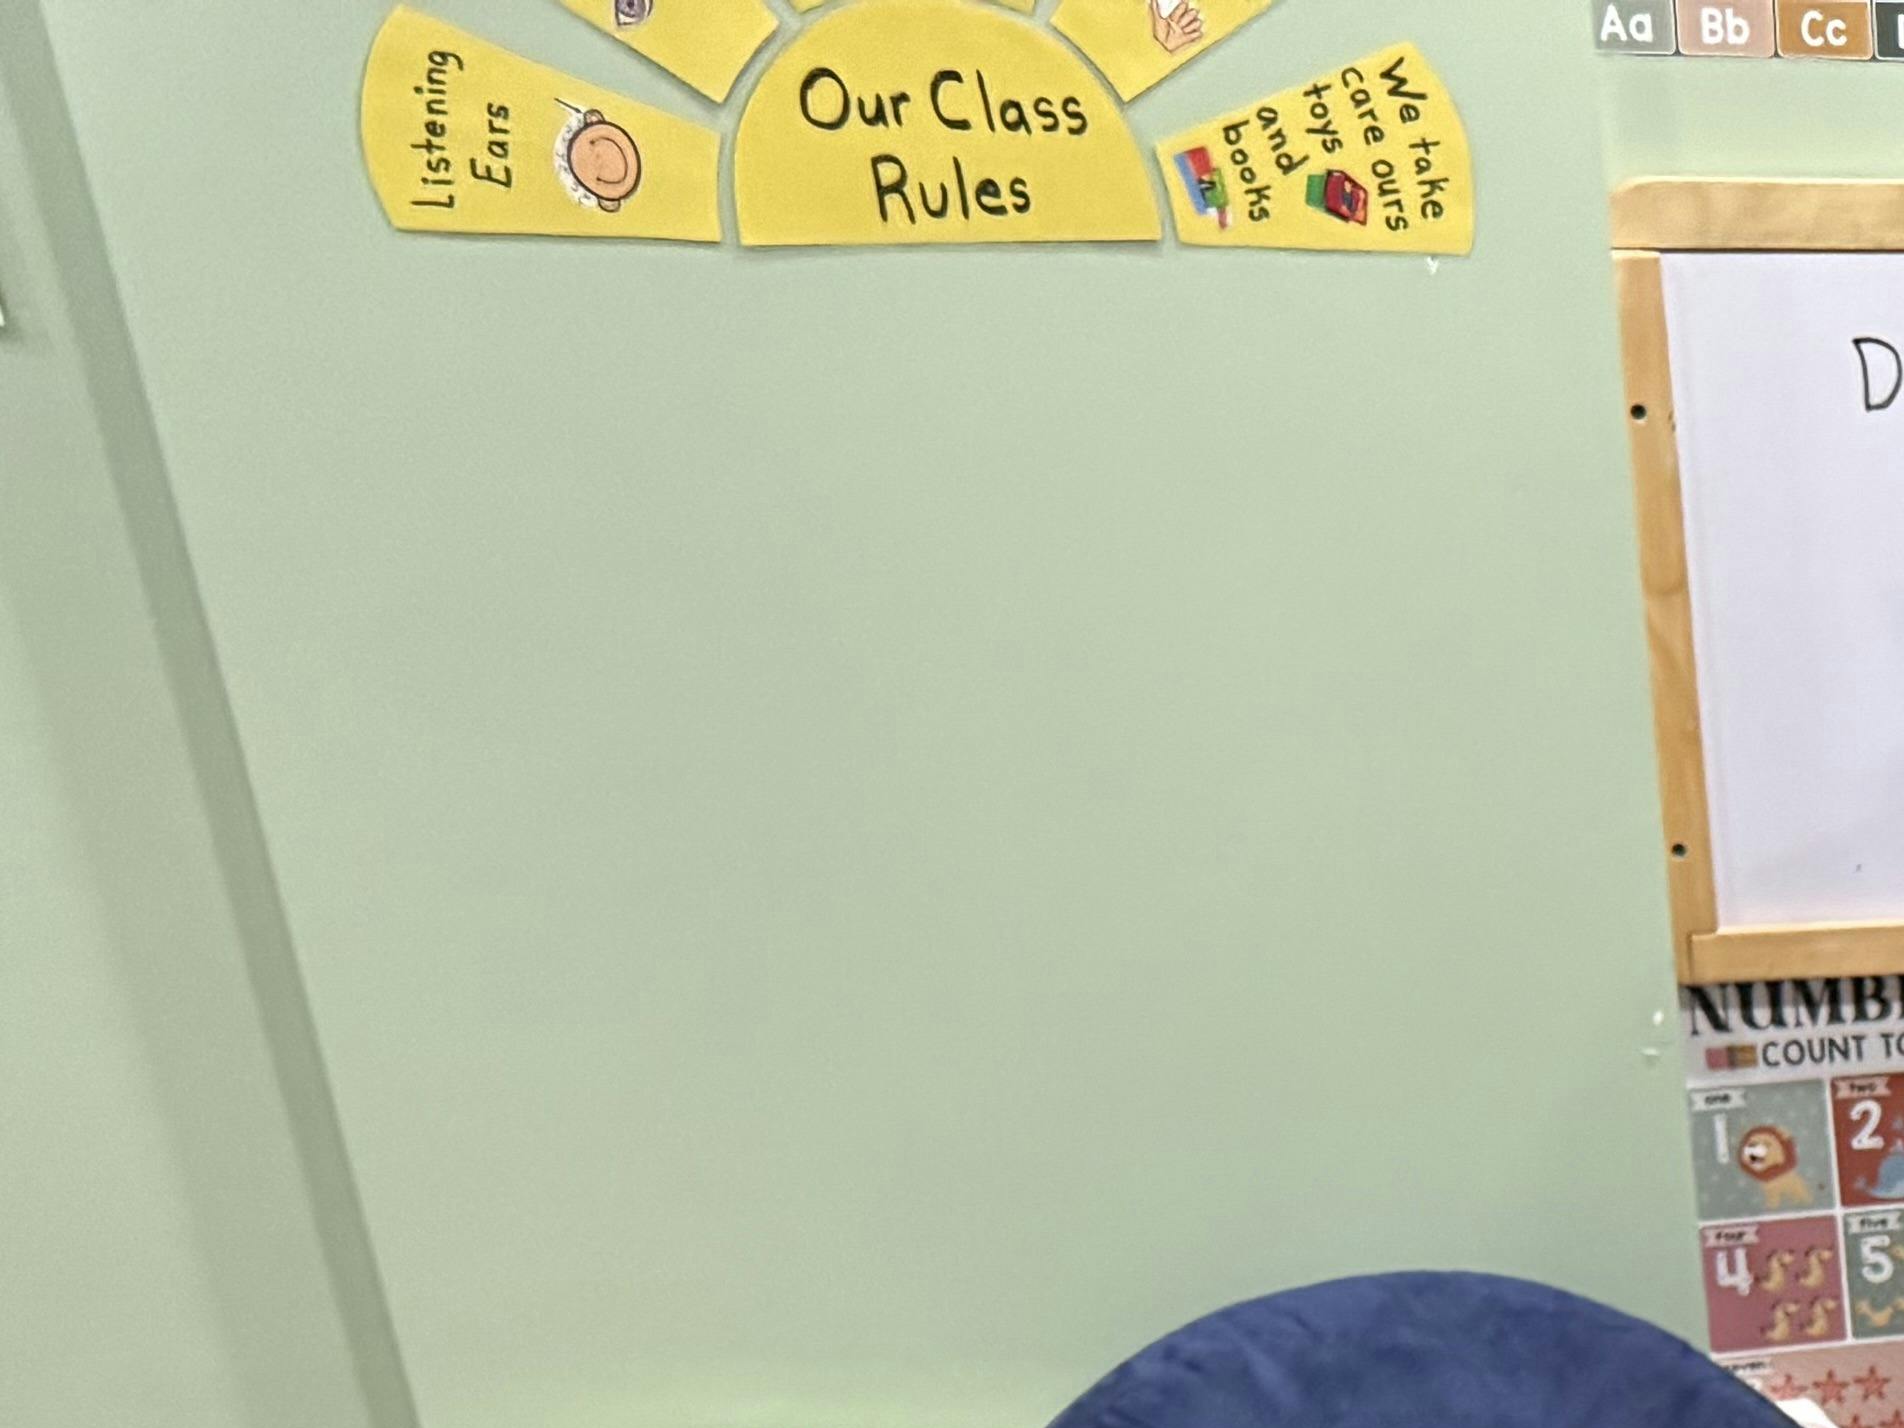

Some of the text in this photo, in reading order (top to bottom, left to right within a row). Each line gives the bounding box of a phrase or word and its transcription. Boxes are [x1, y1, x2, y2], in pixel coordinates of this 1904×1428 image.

[1600, 4, 1653, 43] Aa
[1700, 7, 1751, 45] Bb
[1800, 10, 1848, 47] Cc
[410, 49, 464, 210] Listening
[800, 67, 1088, 136] Our Class
[1303, 83, 1343, 155] toys
[470, 102, 512, 189] Ears
[1222, 119, 1273, 223] books
[1256, 106, 1311, 177] and
[1341, 67, 1410, 232] care ours
[1379, 56, 1450, 221] We take
[871, 153, 1032, 224] Rules
[1760, 1033, 1866, 1068] COUNT
[1712, 1112, 1730, 1165] 1
[1850, 1099, 1885, 1151] 2
[1715, 1247, 1752, 1296] 4
[1860, 1235, 1895, 1284] 5
